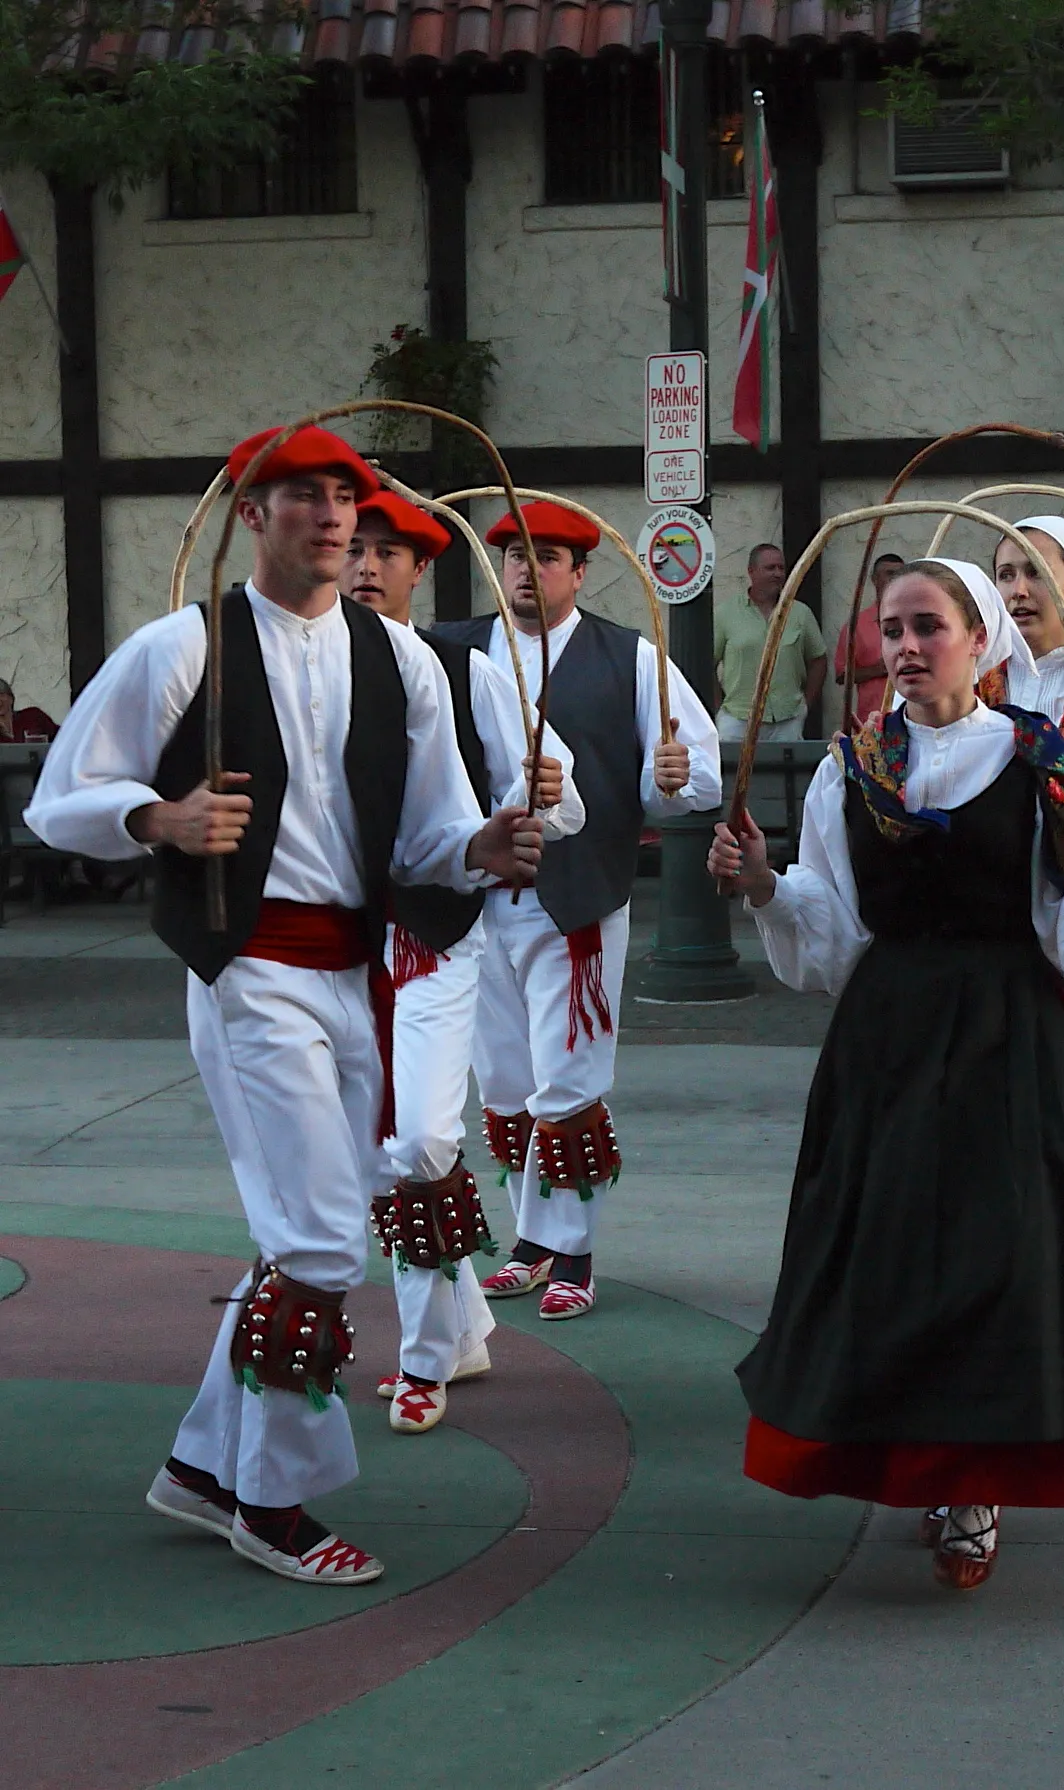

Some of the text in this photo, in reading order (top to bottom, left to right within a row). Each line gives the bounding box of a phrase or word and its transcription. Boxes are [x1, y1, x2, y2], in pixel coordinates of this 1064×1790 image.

[664, 363, 686, 385] NO
[651, 385, 699, 408] PARKING
[653, 408, 697, 424] LOADING
[659, 424, 690, 440] ZONE
[663, 456, 685, 468] ONE
[653, 470, 696, 483] VEHICLE
[661, 485, 688, 497] ONLY
[647, 509, 704, 531] turn your key
